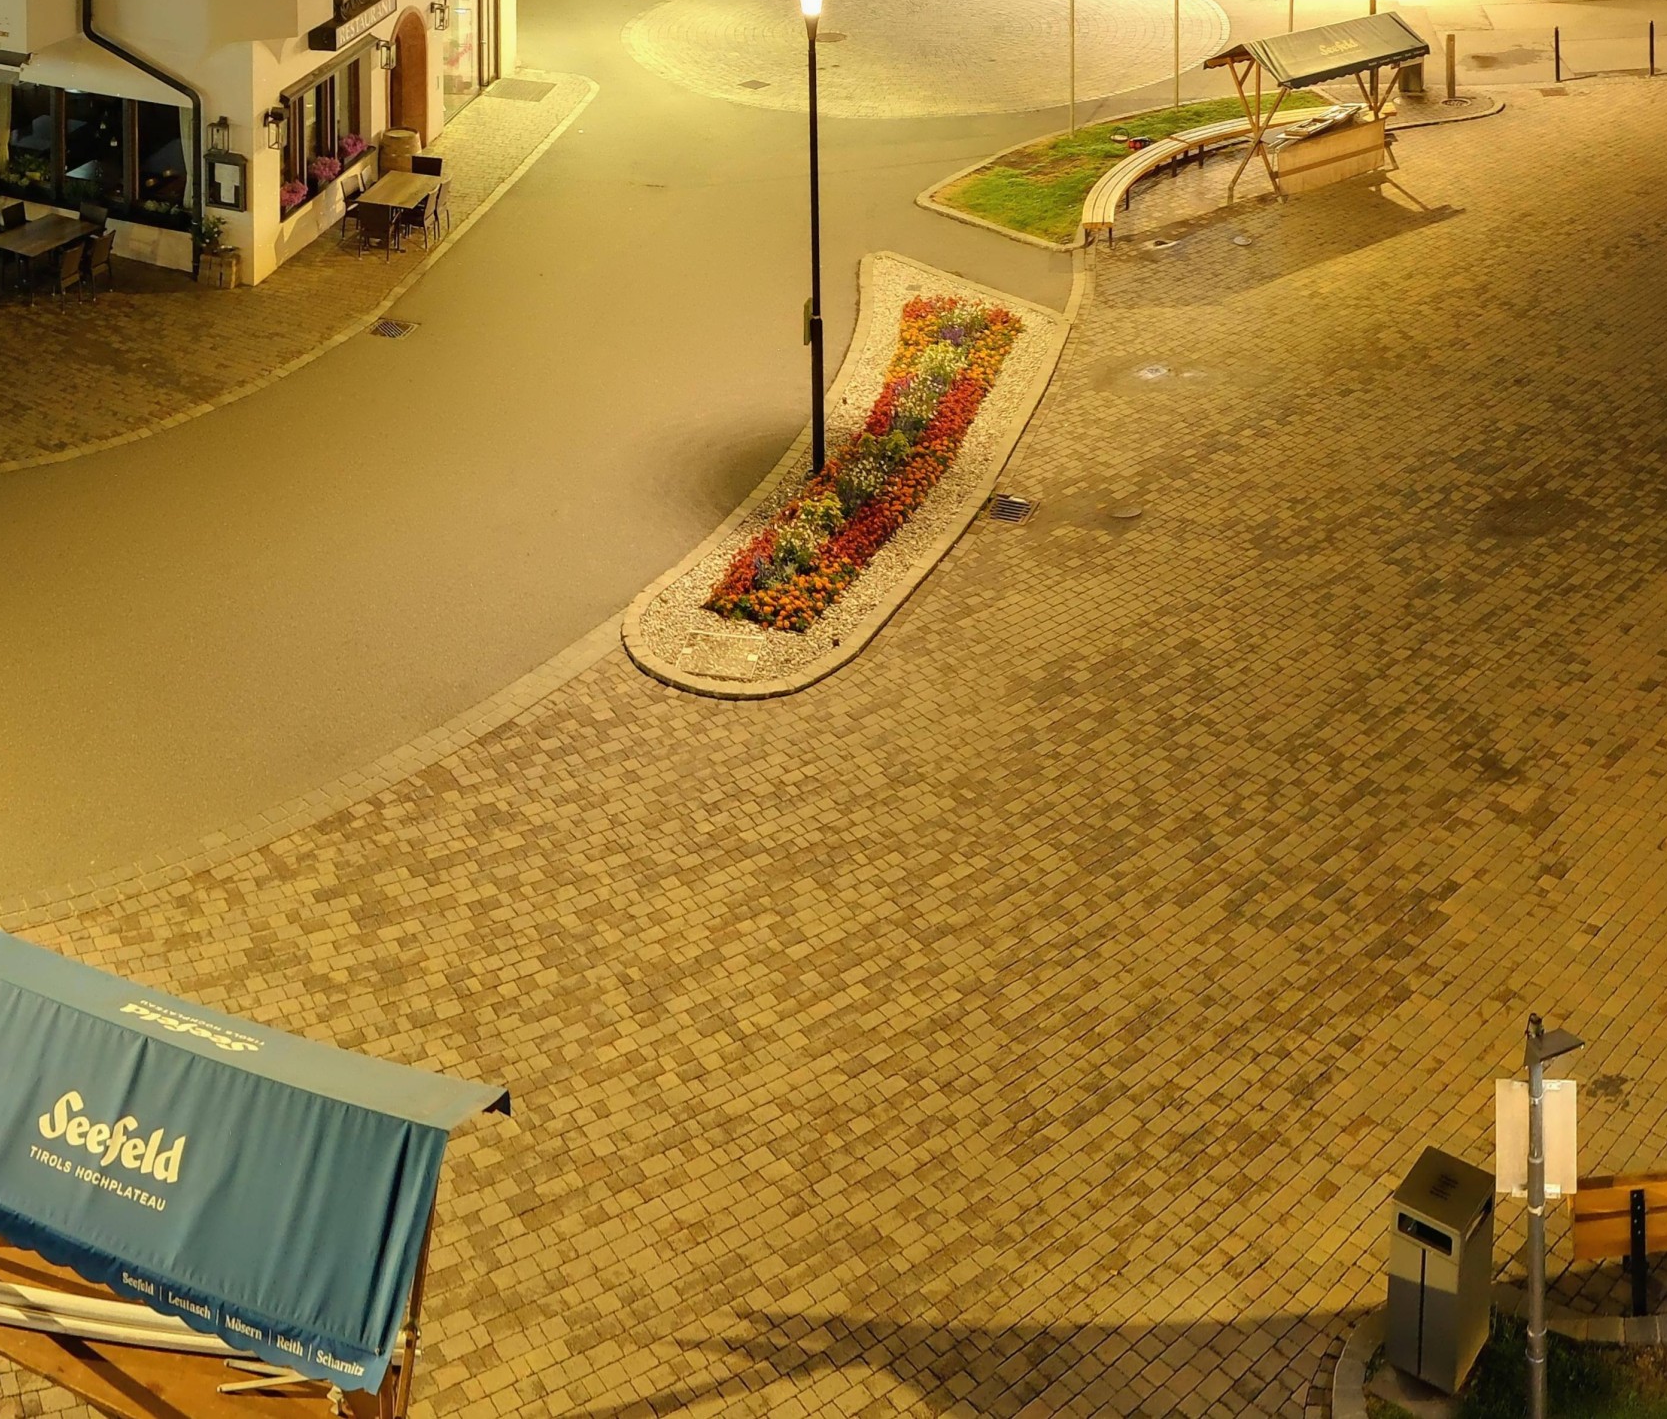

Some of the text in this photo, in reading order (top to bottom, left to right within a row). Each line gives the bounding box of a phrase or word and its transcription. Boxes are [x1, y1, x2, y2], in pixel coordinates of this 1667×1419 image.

[1319, 38, 1359, 56] Seefeld
[119, 1002, 259, 1052] Seefeld
[38, 1090, 187, 1184] Seefeld
[29, 1145, 167, 1212] TIROLS HOCHPLATEAU
[122, 1271, 366, 1377] Seefeld Leutasch Mösern Reith Scharnitz
